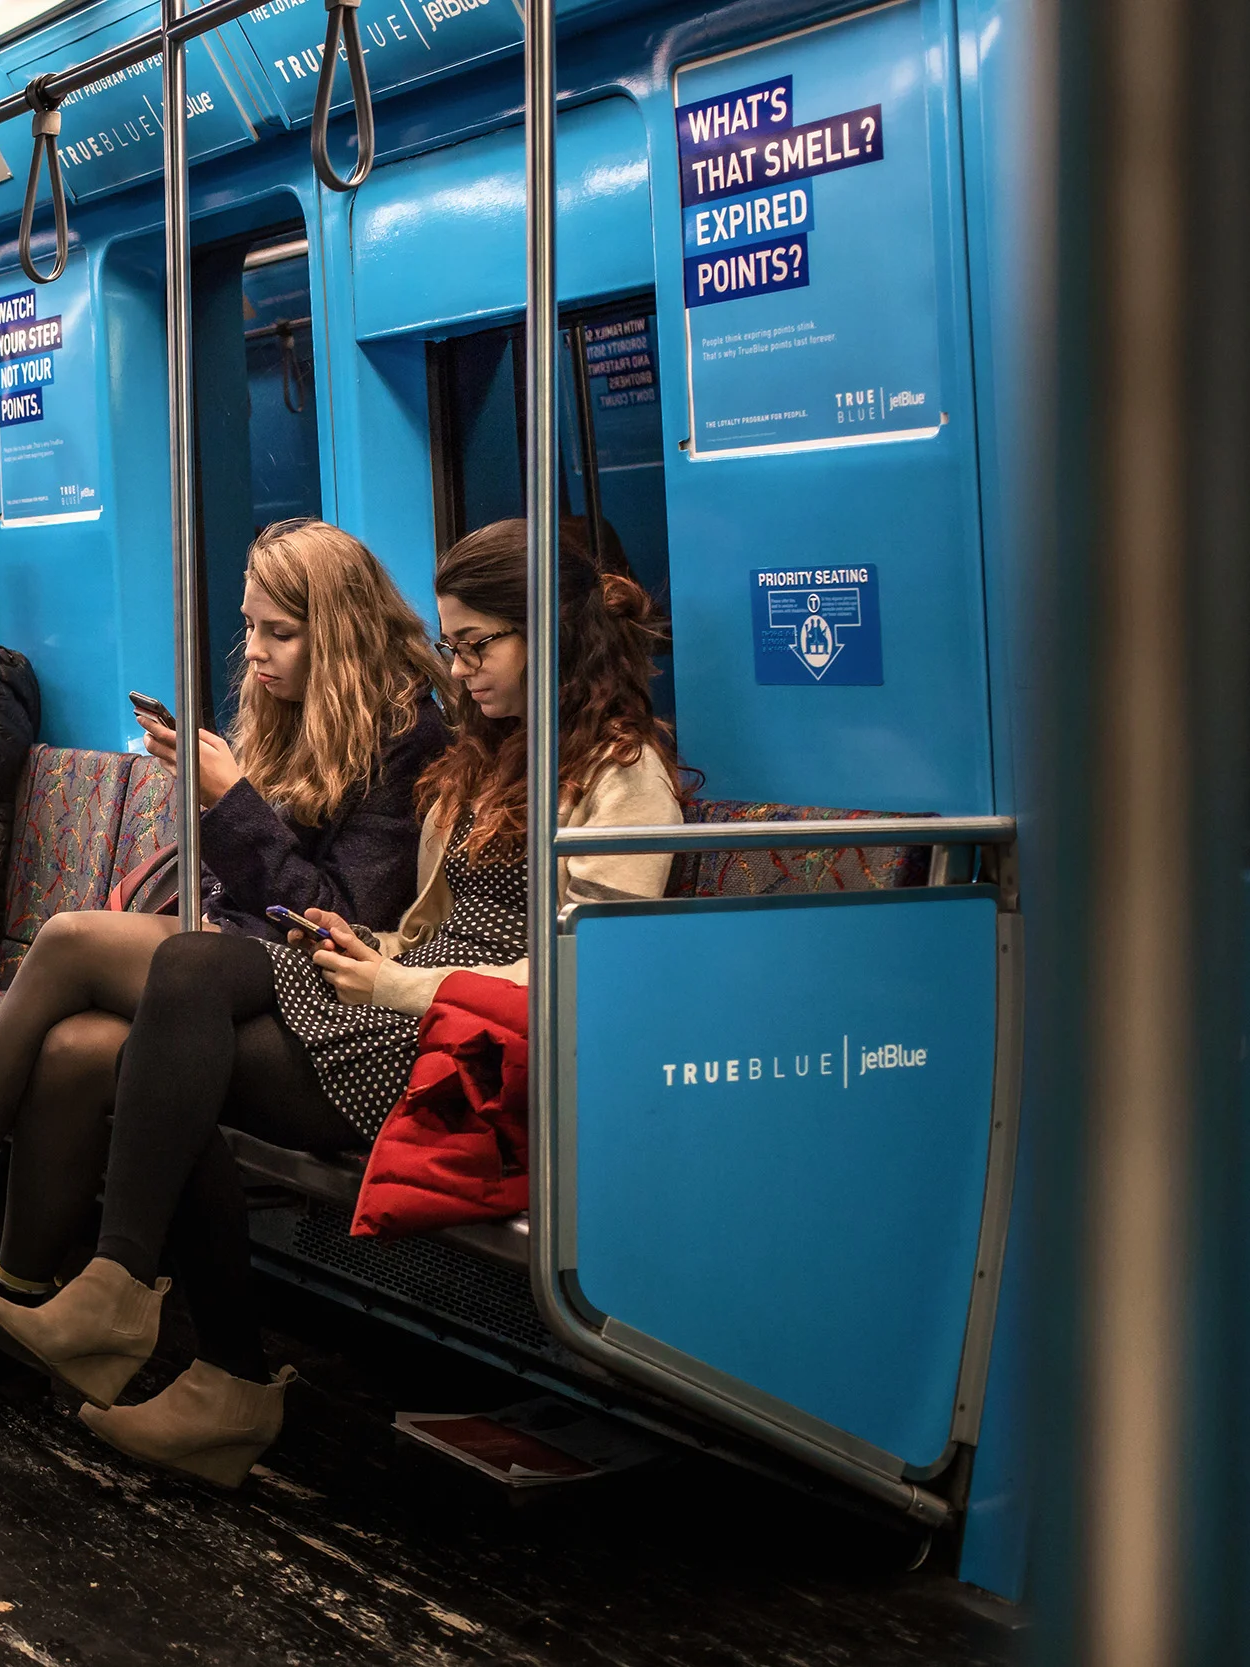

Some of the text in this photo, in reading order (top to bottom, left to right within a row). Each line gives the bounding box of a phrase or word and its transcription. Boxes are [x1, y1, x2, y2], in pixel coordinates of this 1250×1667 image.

[248, 5, 270, 24] THE
[83, 70, 127, 97] PROGRAM
[126, 60, 147, 79] FOR
[688, 87, 787, 144] WHAT'S
[692, 115, 876, 195] THAT SMELL?
[695, 188, 808, 247] EXPIRED
[698, 243, 803, 297] POINTS?
[28, 322, 61, 350] STEP.
[702, 338, 723, 348] People
[725, 333, 742, 344] think
[744, 328, 772, 341] expiring
[773, 324, 795, 338] points
[723, 349, 736, 359] why
[738, 343, 768, 356] TrueBlue
[770, 340, 792, 352] points
[794, 336, 808, 347] last
[0, 357, 52, 390] NOT YOUR
[1, 394, 41, 421] POINTS.
[835, 389, 875, 407] TRUE
[889, 390, 925, 411] jetBlue
[705, 409, 808, 428] THE LOYALTY PROGRAM FOR PEOPLE.
[837, 407, 876, 424] BLUE
[758, 568, 868, 586] PRIORITY SEATING
[859, 1044, 927, 1075] jetBlue
